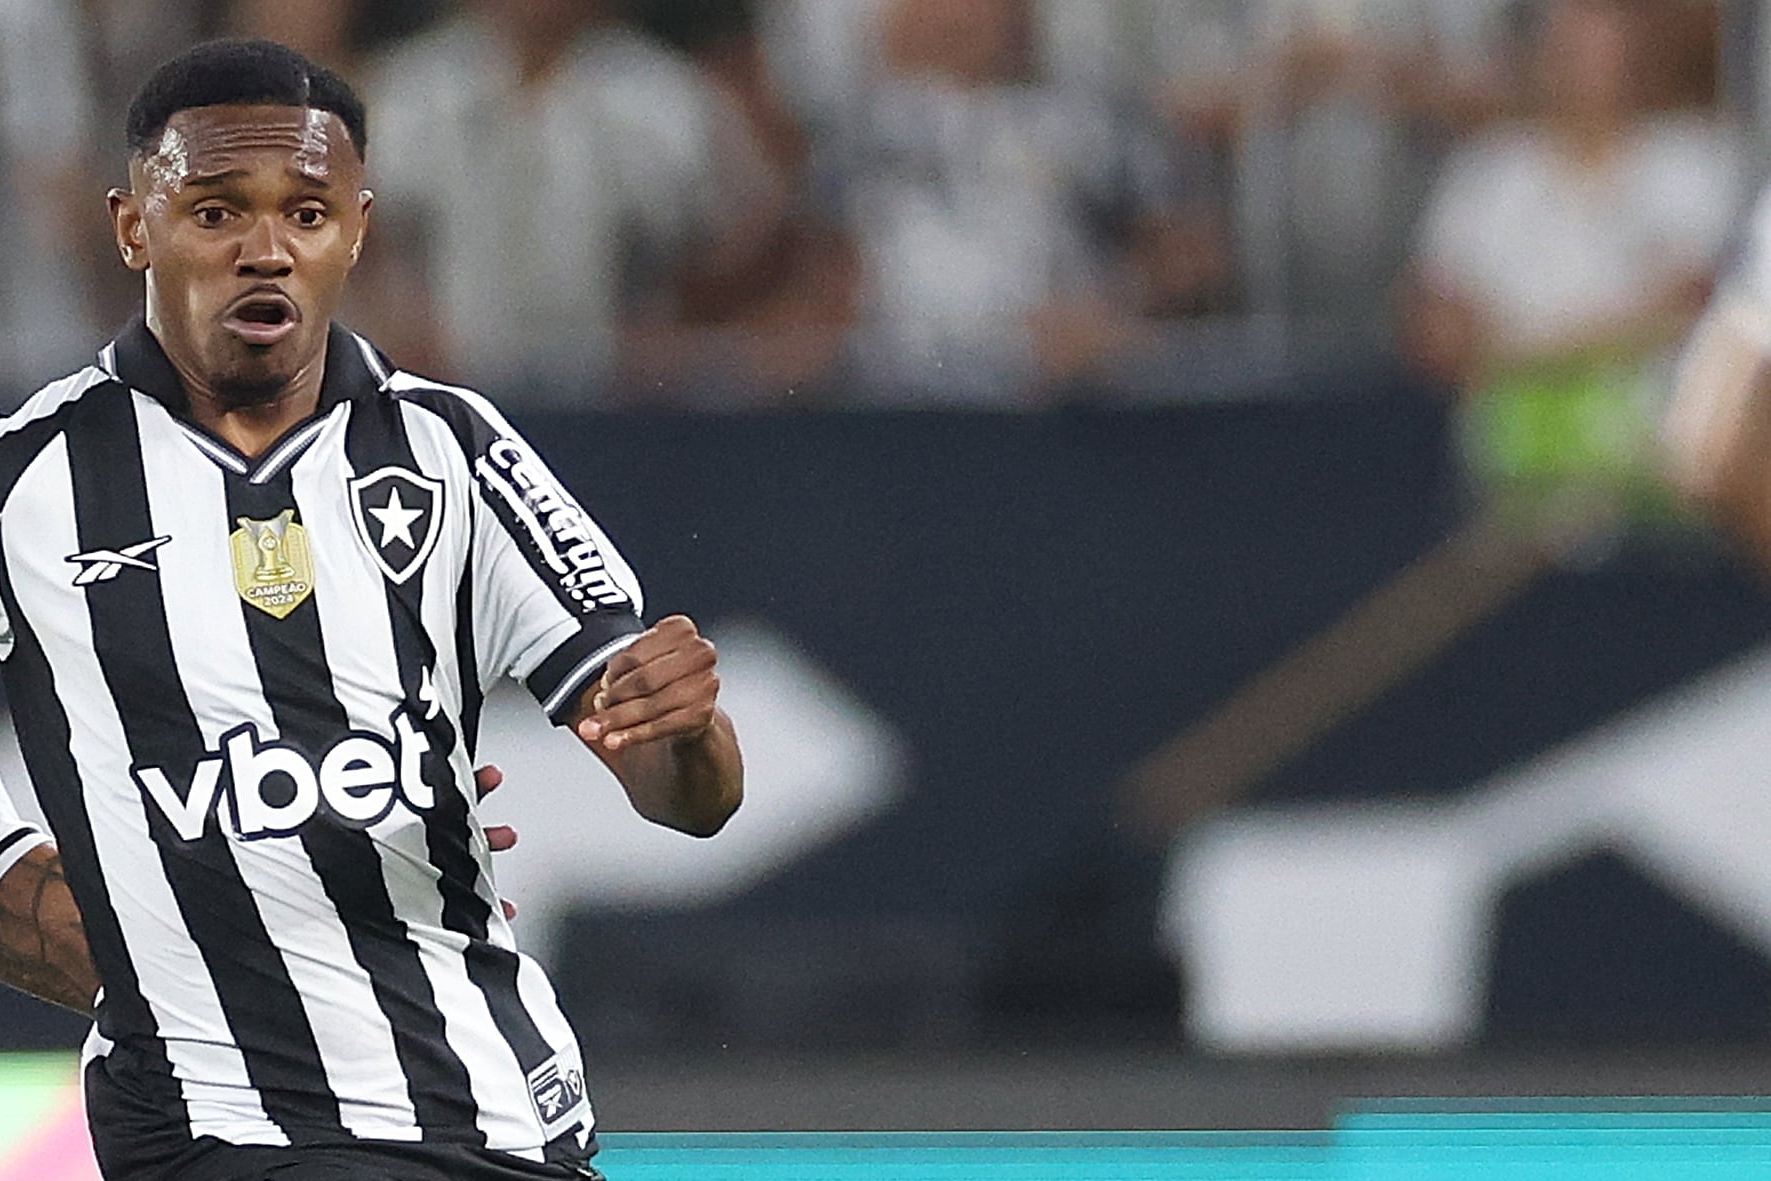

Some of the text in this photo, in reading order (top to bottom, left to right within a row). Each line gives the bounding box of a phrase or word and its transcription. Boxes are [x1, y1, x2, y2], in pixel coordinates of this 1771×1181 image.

[489, 439, 628, 605] Centrum
[264, 595, 294, 605] 2024
[134, 711, 436, 842] vbet
